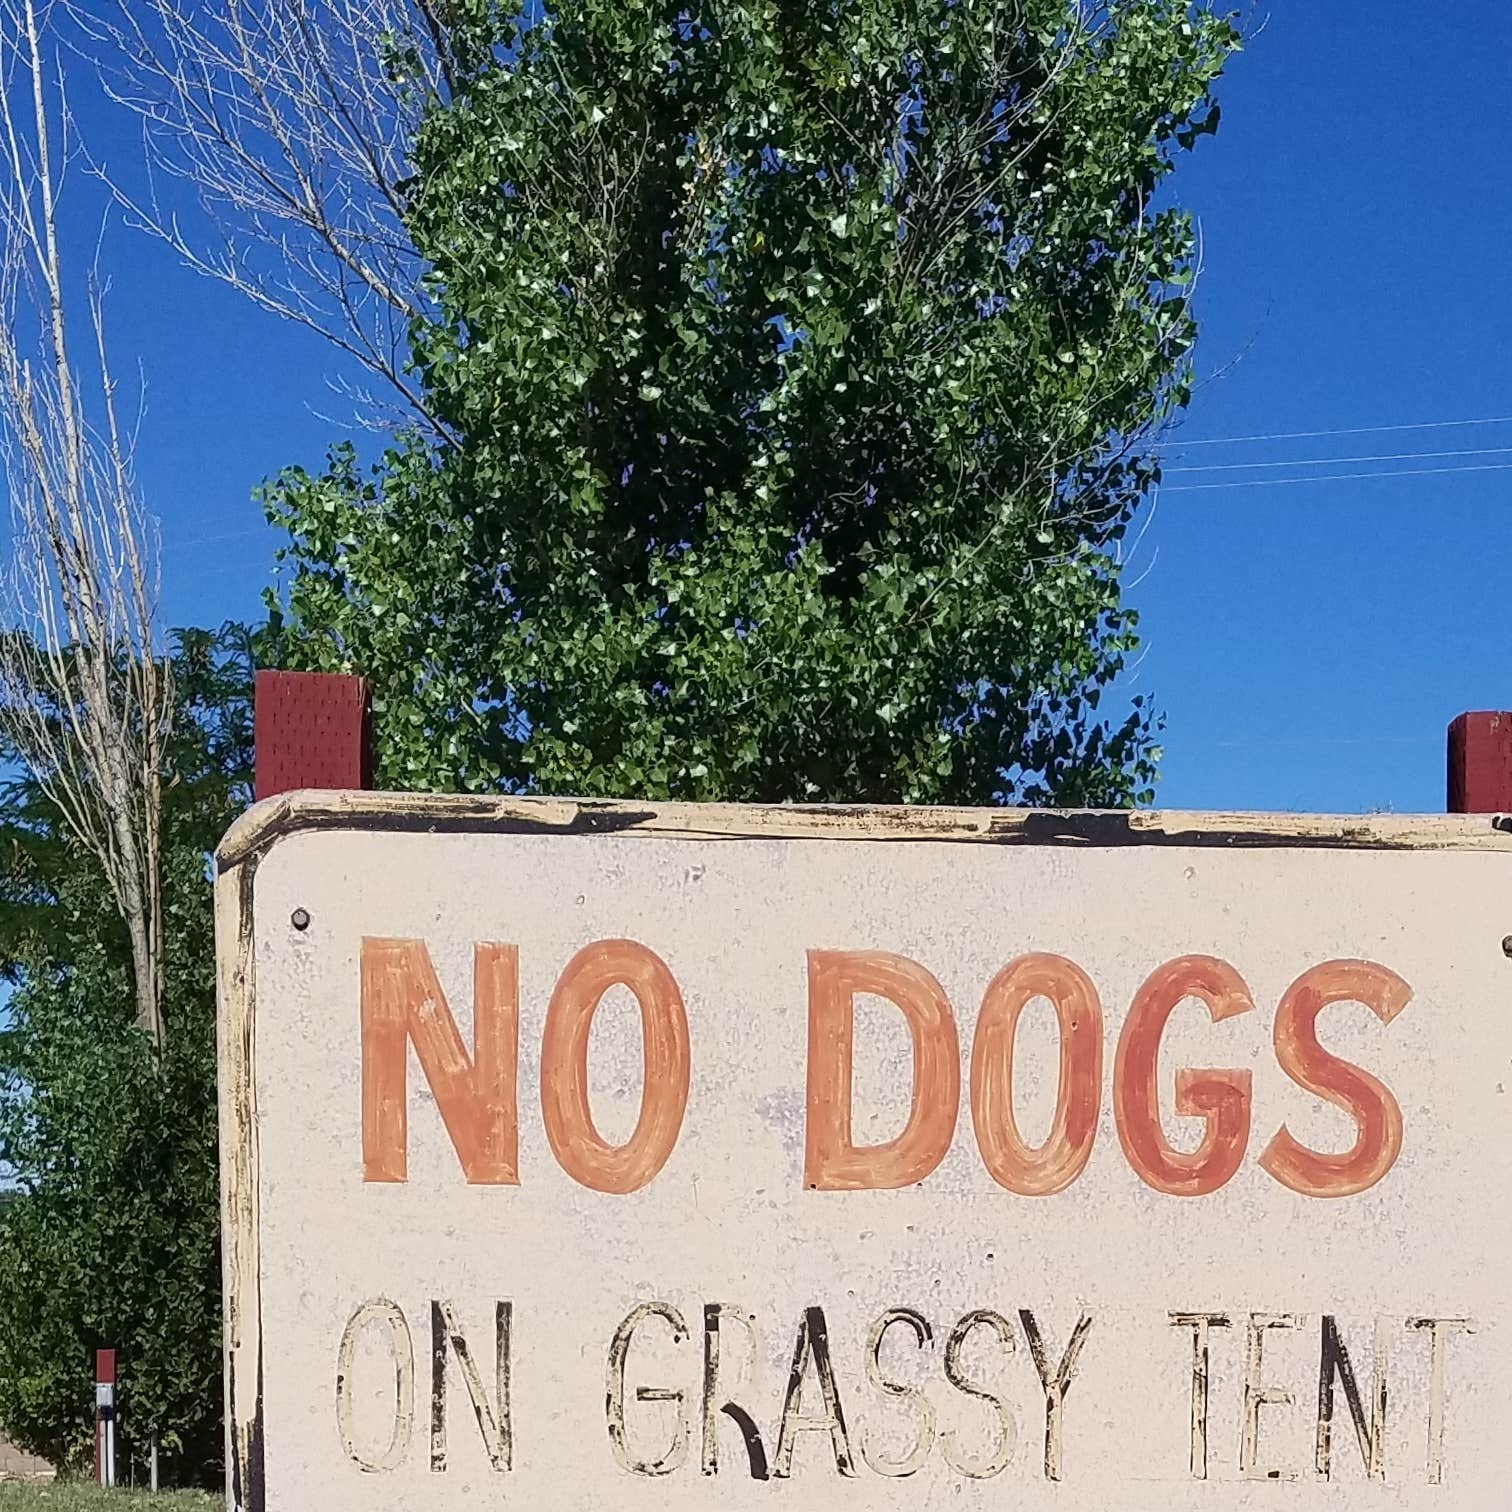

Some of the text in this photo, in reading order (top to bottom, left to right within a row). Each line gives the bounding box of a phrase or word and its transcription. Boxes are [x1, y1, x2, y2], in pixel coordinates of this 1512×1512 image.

[360, 936, 1414, 1199] NO DOGS
[336, 1298, 1478, 1485] ON GRASSY TENT
